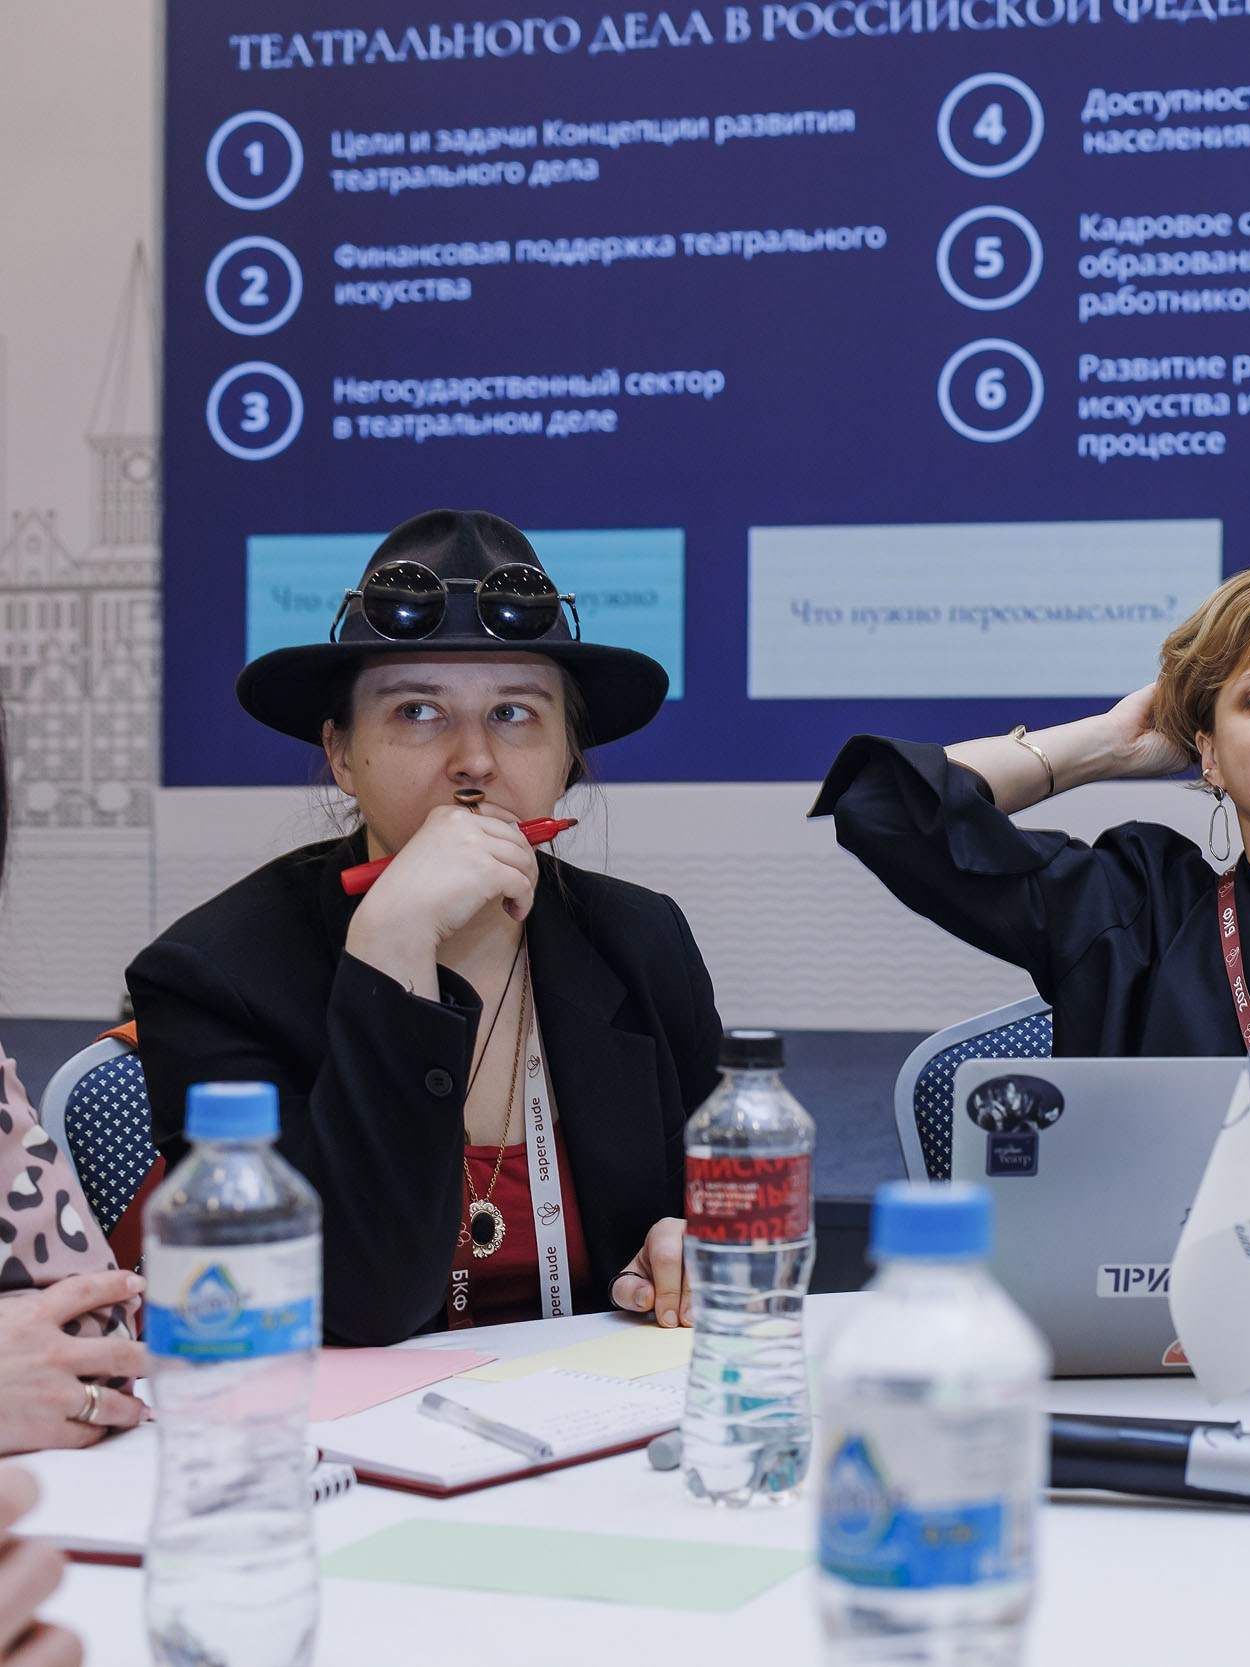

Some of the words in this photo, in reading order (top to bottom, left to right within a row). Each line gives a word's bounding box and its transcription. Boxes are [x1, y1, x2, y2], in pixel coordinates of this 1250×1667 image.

[229, 16, 581, 71] ТЕАТРАЛЬНОГО
[588, 9, 713, 54] ДЕЛА
[725, 5, 751, 44] В
[331, 129, 405, 163] Цели
[410, 130, 431, 154] и
[434, 126, 537, 156] задачи
[543, 118, 709, 149] Концепции
[714, 109, 855, 146] развития
[974, 105, 1006, 145] 4
[243, 142, 264, 176] 1
[331, 161, 526, 197] театрального
[528, 157, 599, 189] дела
[334, 240, 510, 269] Финансовая
[514, 233, 676, 268] поддержка
[681, 225, 888, 261] театрального
[1079, 211, 1233, 246] Кадровое
[974, 237, 1004, 279] 5
[240, 266, 269, 306] 2
[334, 277, 472, 311] искусства
[1079, 353, 1227, 384] Развитие
[333, 368, 620, 409] Негосударственный
[624, 369, 725, 400] сектор
[976, 370, 1006, 410] 6
[241, 393, 270, 432] 3
[333, 416, 352, 440] в
[356, 411, 543, 443] театральном
[546, 408, 619, 439] деле
[1078, 391, 1232, 427] искусства
[1077, 431, 1227, 465] процессе
[791, 598, 843, 627] Что
[850, 603, 942, 633] нужно
[948, 595, 1178, 632] переосмыслить?
[1222, 907, 1236, 938] БКФ
[1234, 976, 1249, 1013] 2026
[532, 1097, 544, 1132] aude
[538, 1135, 550, 1182] sapere
[548, 1245, 560, 1280] aude
[452, 1269, 469, 1312] БКФ
[551, 1282, 563, 1317] pere
